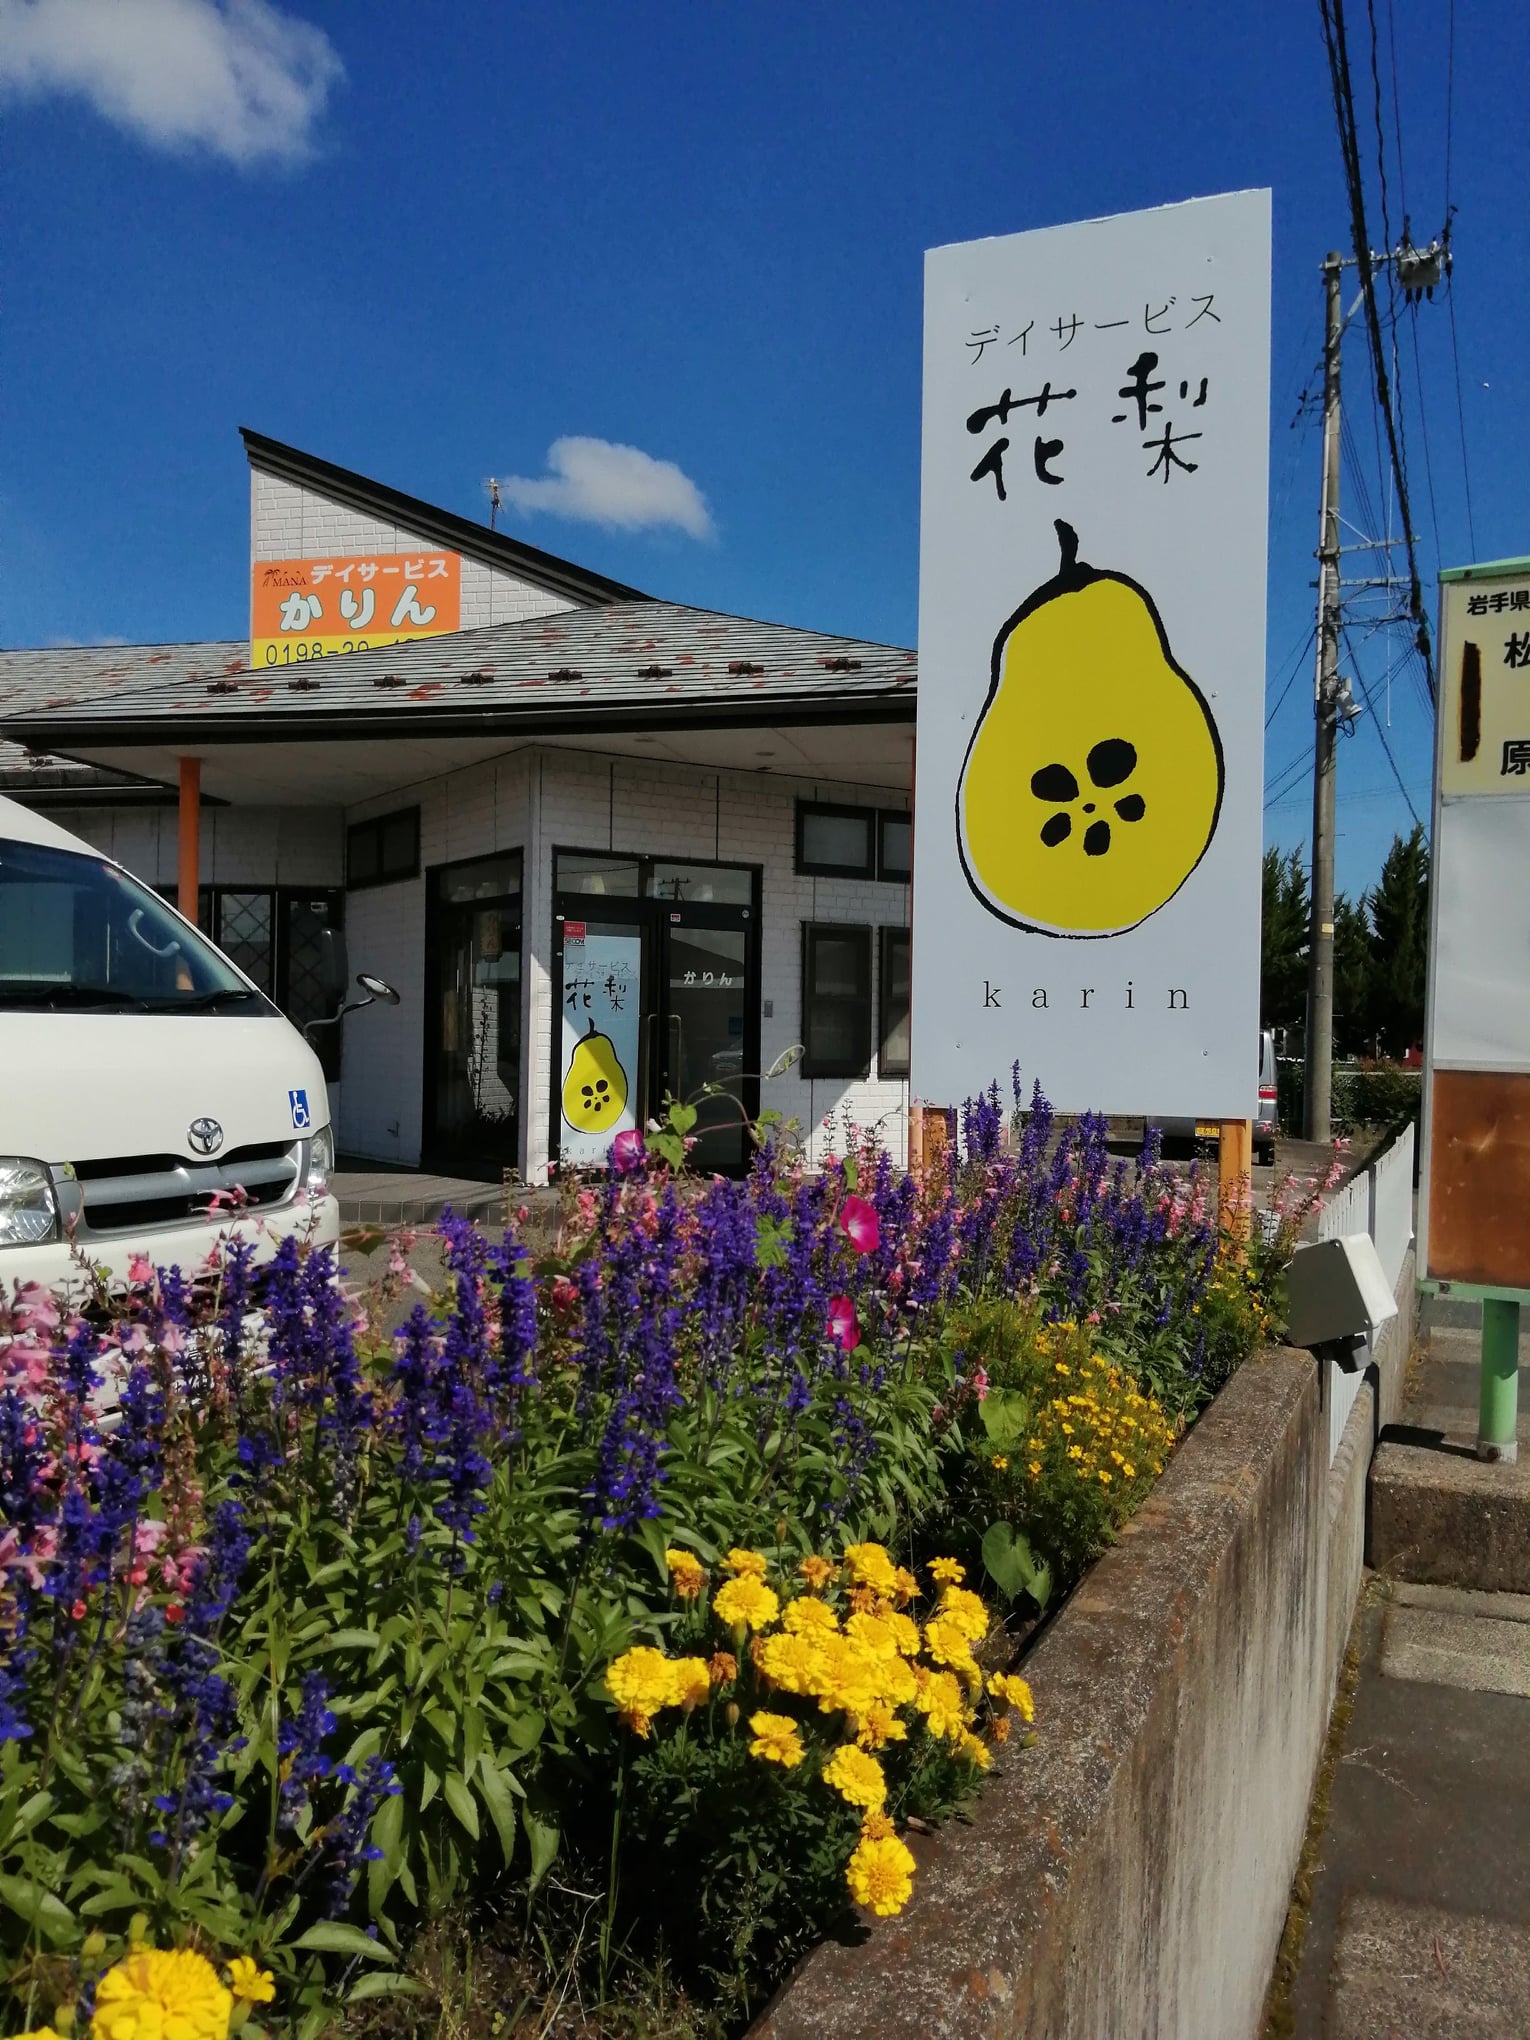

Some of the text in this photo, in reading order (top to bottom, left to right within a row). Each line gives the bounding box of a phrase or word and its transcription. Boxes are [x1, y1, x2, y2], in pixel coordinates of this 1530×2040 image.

[965, 294, 1221, 365] デイサービス
[966, 351, 1209, 501] 花梨
[311, 559, 449, 584] デイサービス
[279, 584, 437, 631] かりん
[565, 975, 627, 1013] 花梨
[683, 970, 733, 986] かりん
[982, 980, 1190, 1009] karin
